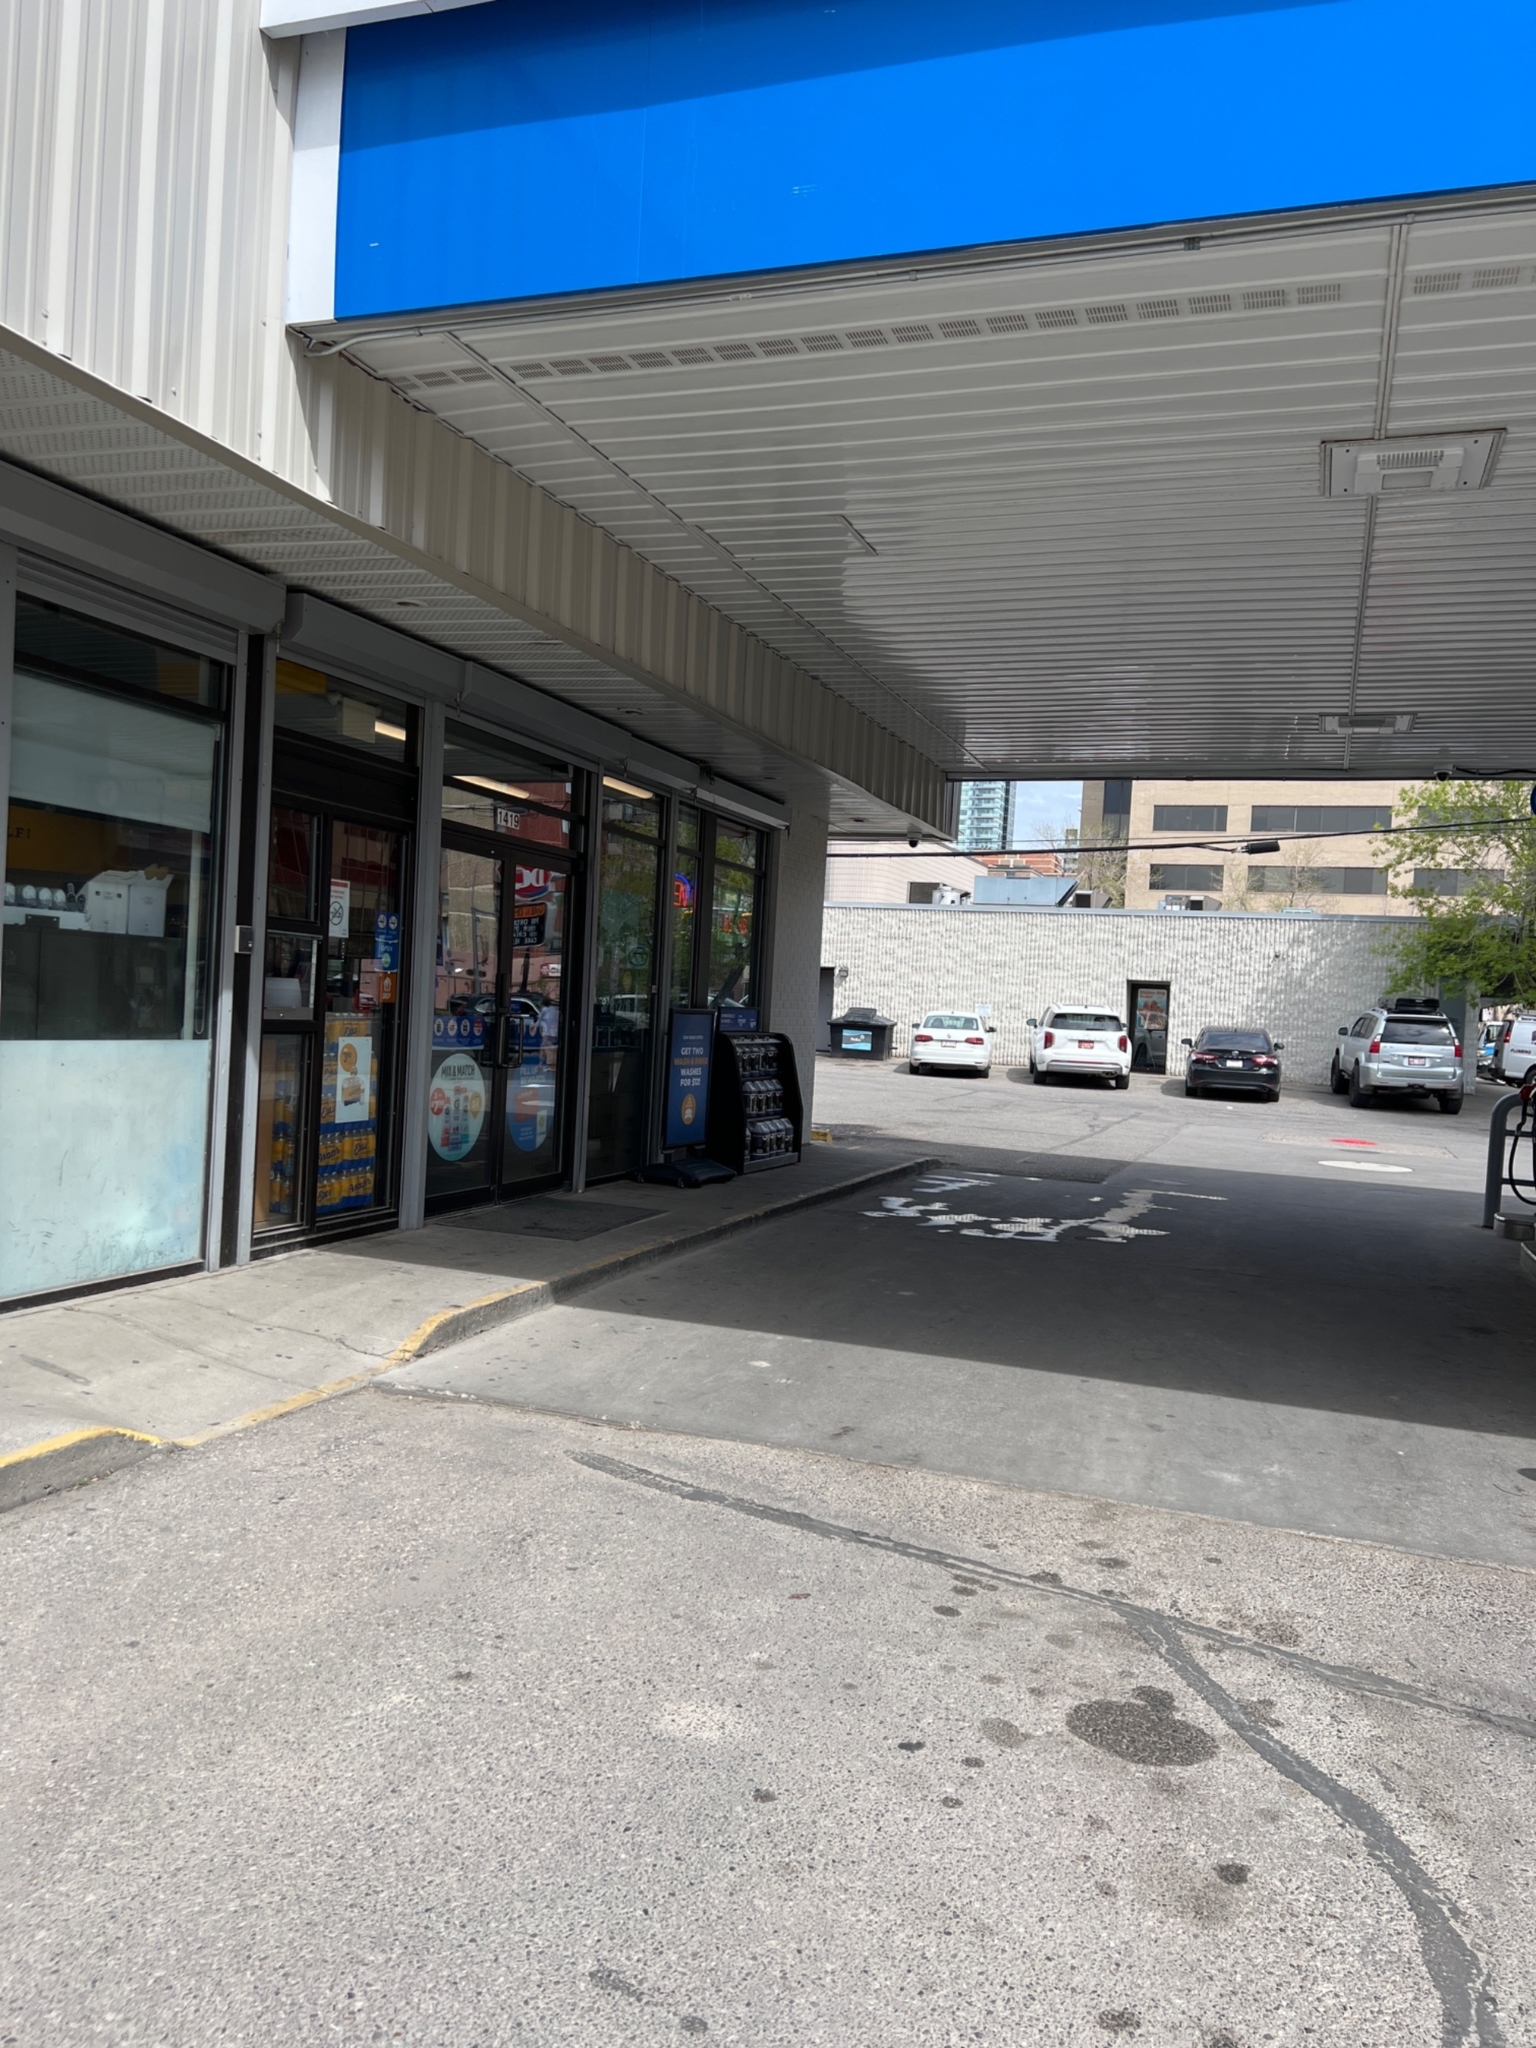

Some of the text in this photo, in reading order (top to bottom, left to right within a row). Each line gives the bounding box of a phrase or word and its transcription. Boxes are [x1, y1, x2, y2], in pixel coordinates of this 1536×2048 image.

[499, 811, 519, 828] 1419
[680, 1046, 704, 1055] GET TWO
[441, 1065, 452, 1078] MIX
[457, 1064, 475, 1077] MATCH
[680, 1067, 702, 1076] WASHES
[680, 1078, 691, 1087] FOR
